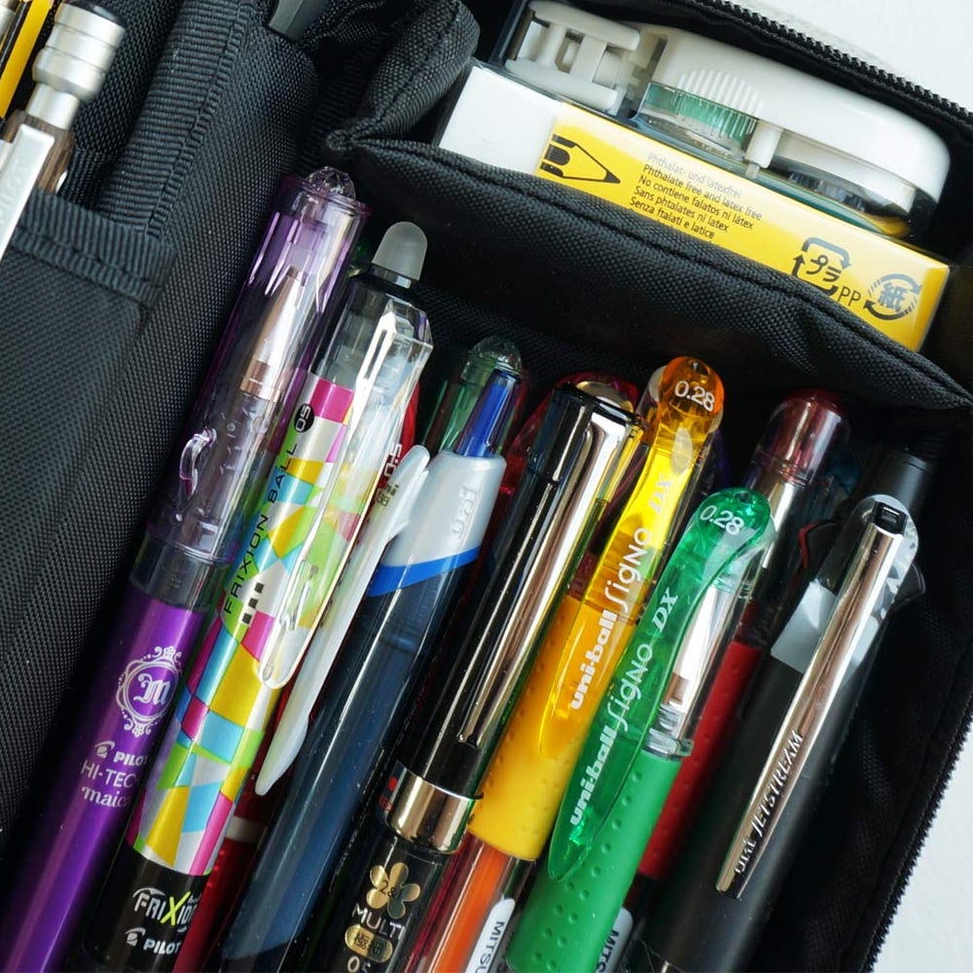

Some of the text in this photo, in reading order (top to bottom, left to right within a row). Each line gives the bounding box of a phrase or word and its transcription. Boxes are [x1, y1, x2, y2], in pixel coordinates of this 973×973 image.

[638, 174, 652, 187] No
[653, 181, 690, 203] contiene
[691, 197, 721, 216] falatos
[722, 210, 732, 221] ni
[643, 164, 763, 221] Phthalate free and latex free
[688, 171, 705, 185] und
[629, 196, 655, 215] Senza
[657, 208, 684, 225] ftalati
[683, 220, 691, 229] e
[690, 221, 715, 239] latice
[634, 186, 730, 233] Sans phtalates ni latex
[804, 251, 845, 284] プラ
[837, 285, 862, 306] PP
[674, 380, 716, 412] 0.28
[295, 403, 313, 434] 05
[223, 442, 298, 616] FRIXION BALL
[700, 504, 745, 536] 0.28
[569, 610, 618, 710] uni-ball
[647, 476, 673, 514] DX
[569, 726, 618, 826] uni-ball
[652, 588, 679, 633] DX
[751, 729, 804, 838] JETSTREAM
[351, 902, 406, 941] MULTI
